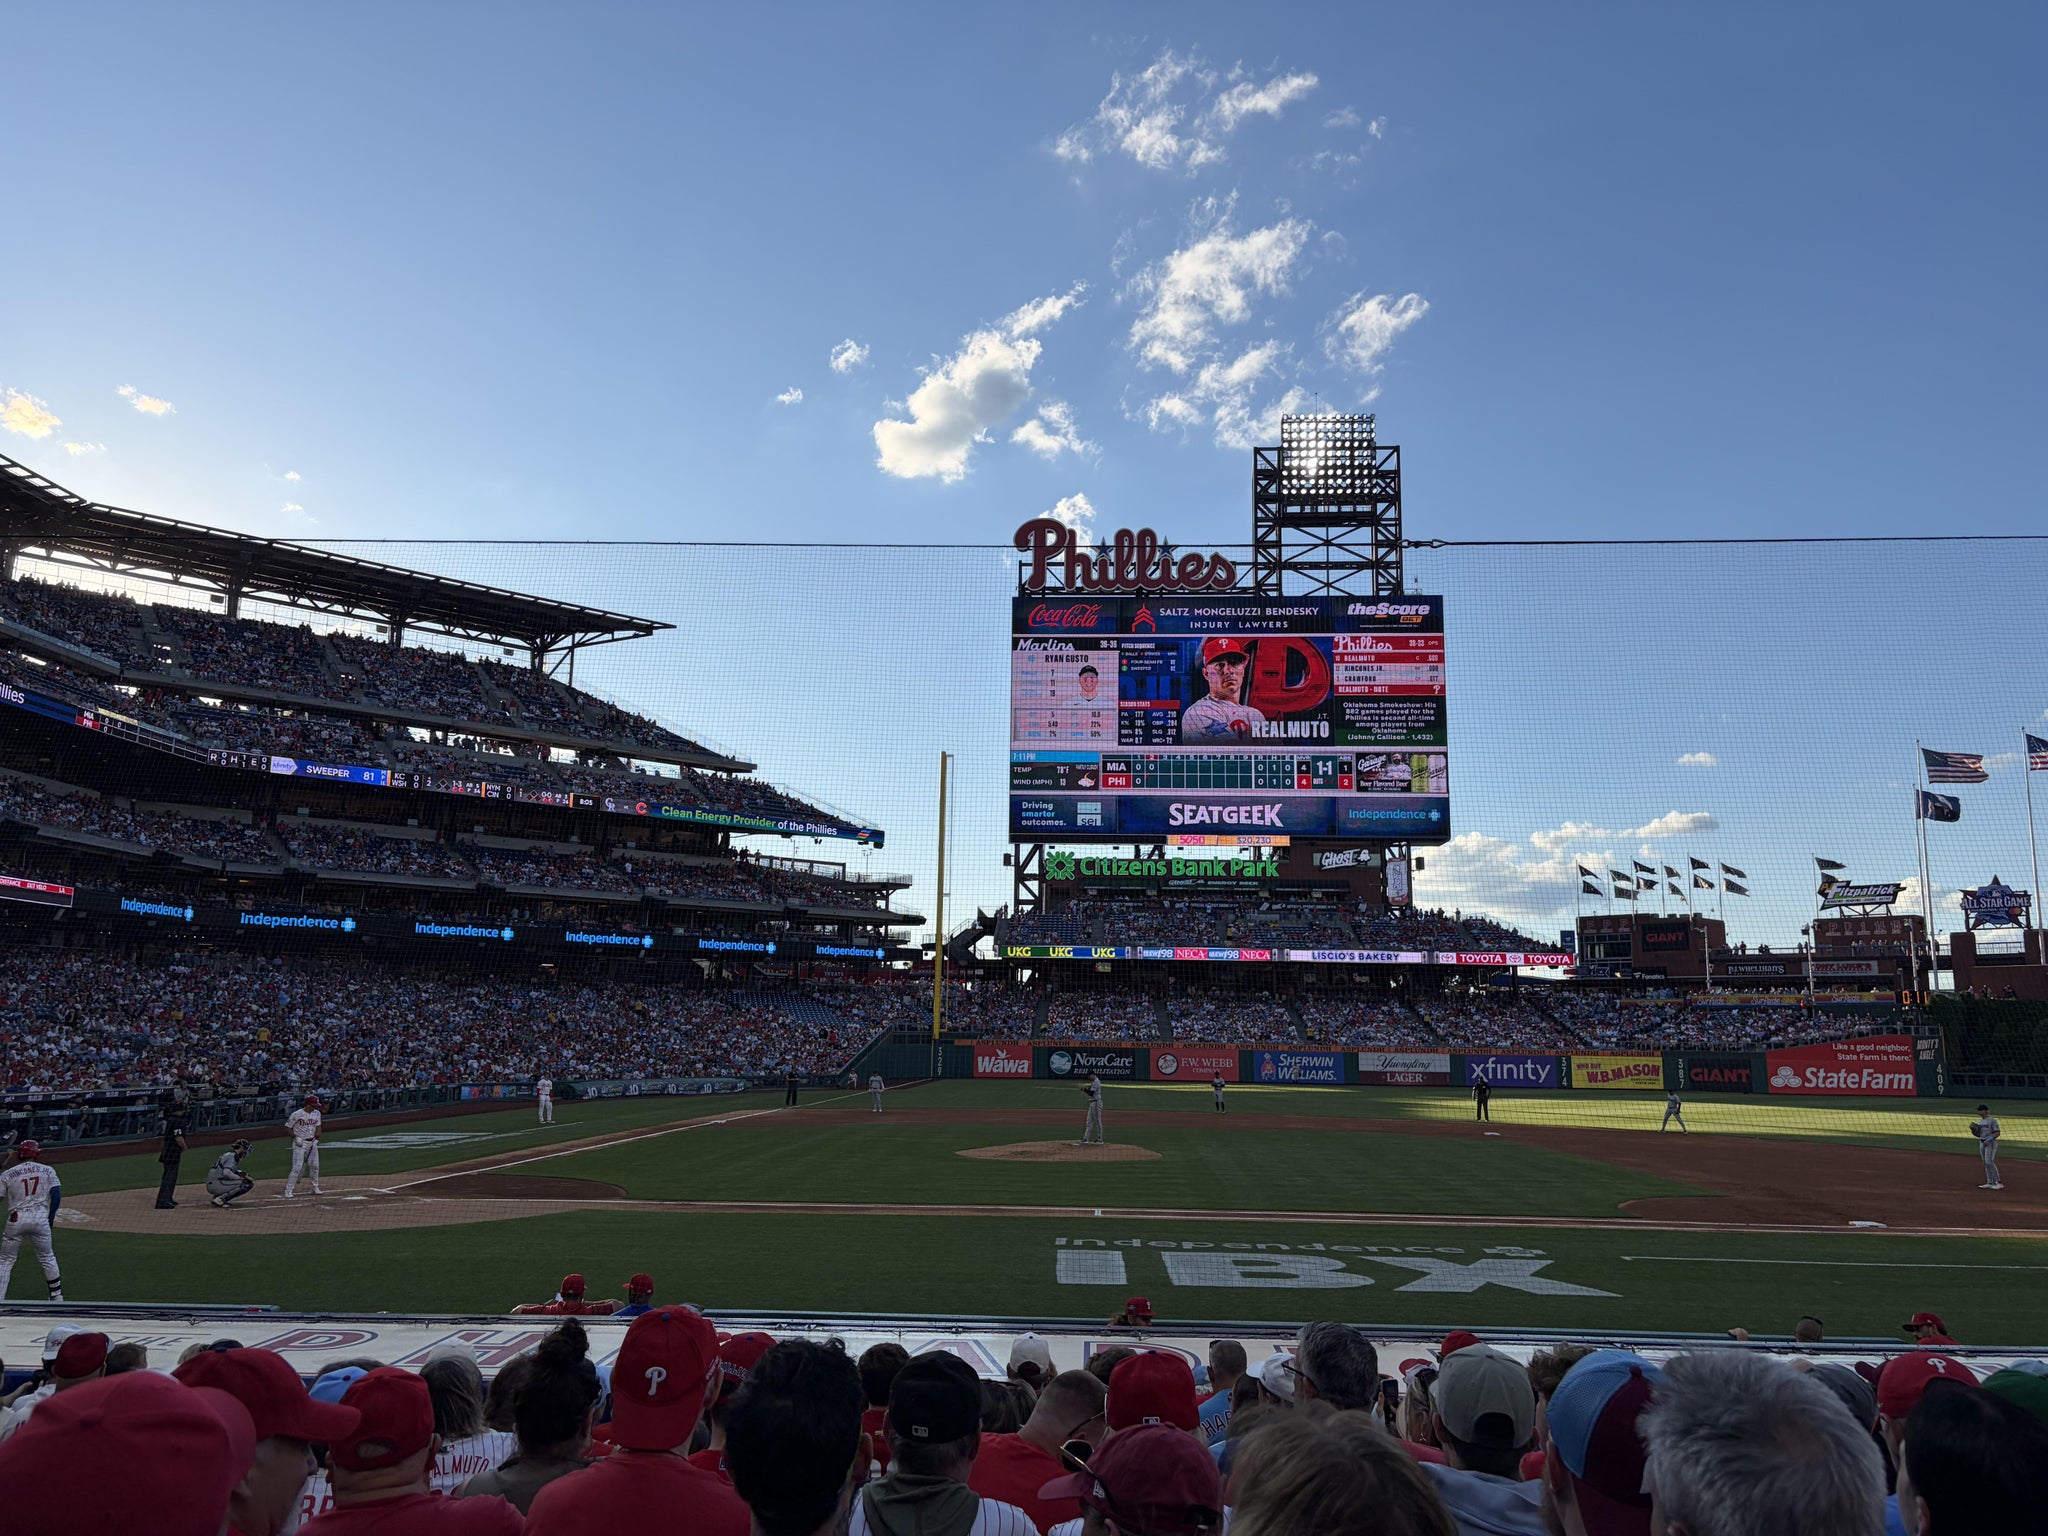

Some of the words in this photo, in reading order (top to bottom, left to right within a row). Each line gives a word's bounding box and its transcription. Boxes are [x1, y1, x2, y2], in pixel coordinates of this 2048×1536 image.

[1014, 517, 1236, 591] Phillies
[1160, 608, 1189, 616] SALTZ
[1194, 607, 1261, 616] MONGELUZZI
[1265, 607, 1319, 616] BENDESKY
[1347, 603, 1430, 615] theScore
[1190, 621, 1230, 629] INJURY
[1239, 621, 1288, 629] LAWYERS
[1017, 638, 1075, 651] Marlins
[1334, 636, 1392, 652] Phillies
[1045, 655, 1064, 663] RYAN
[1066, 655, 1089, 663] GUSTO
[84, 711, 94, 720] MIA
[84, 719, 93, 728] PHI
[1252, 721, 1330, 738] REALMUTO
[1107, 762, 1127, 771] MIA
[1317, 761, 1332, 775] 1-1
[1358, 755, 1386, 772] Garage
[306, 765, 350, 778] SWEEPER
[364, 771, 374, 781] 81
[1108, 776, 1126, 785] PHI
[1022, 802, 1053, 810] Driving
[662, 806, 693, 819] Clean
[695, 810, 731, 825] Energy
[733, 814, 776, 828] Provider
[778, 820, 788, 830] of
[790, 821, 804, 832] the
[806, 823, 837, 836] Phillies
[1169, 803, 1284, 827] SEATGEEK
[1350, 810, 1426, 820] Independence
[1237, 836, 1271, 844] $20,230
[1321, 849, 1360, 868] GHOST
[1080, 857, 1166, 876] Citizens
[1172, 856, 1226, 876] Bank
[1230, 857, 1279, 877] Park
[1825, 883, 1896, 899] Fitzpatrick
[121, 897, 183, 917] Independence
[1962, 898, 1979, 909] ALL
[1980, 897, 2003, 908] STAR
[2004, 896, 2030, 907] GAME
[240, 912, 338, 929] Independence
[415, 922, 499, 938] Independence
[565, 931, 640, 945] Independence
[1646, 932, 1684, 943] GIANT
[698, 938, 764, 952] Independence
[816, 945, 874, 958] Independence
[1007, 947, 1031, 957] UKG
[1050, 948, 1074, 957] UKG
[1091, 948, 1116, 957] UKG
[1177, 949, 1205, 958] NECA
[1242, 950, 1271, 960] NECA
[1312, 952, 1355, 961] LISCIO'S
[1359, 952, 1399, 961] BAKERY
[1460, 954, 1503, 963] TOYOTA
[1528, 954, 1570, 964] TOYOTA
[1642, 972, 1665, 981] Fanatics
[1832, 1043, 1848, 1051] Like
[1856, 1044, 1874, 1052] good
[1917, 1040, 1939, 1050] MONTY'S
[1074, 1053, 1133, 1067] NovaCare
[1278, 1054, 1334, 1067] SHERWIN
[1837, 1053, 1858, 1061] State
[1919, 1050, 1935, 1061] ANGLE
[978, 1056, 1028, 1073] Wawa
[1182, 1058, 1198, 1066] F.W.
[1202, 1058, 1233, 1068] WEBB
[1376, 1054, 1434, 1071] Yuengling
[1471, 1057, 1550, 1083] xfinity
[1690, 1068, 1750, 1083] GIANT
[1387, 1073, 1423, 1083] LAGER
[1936, 1064, 1944, 1094] 409
[8, 1168, 40, 1179] RINCONES
[22, 1176, 39, 1197] 17
[1056, 1237, 1464, 1255] Independence
[1056, 1249, 1623, 1297] IBX
[1928, 1358, 1947, 1374] P
[645, 1366, 667, 1396] P
